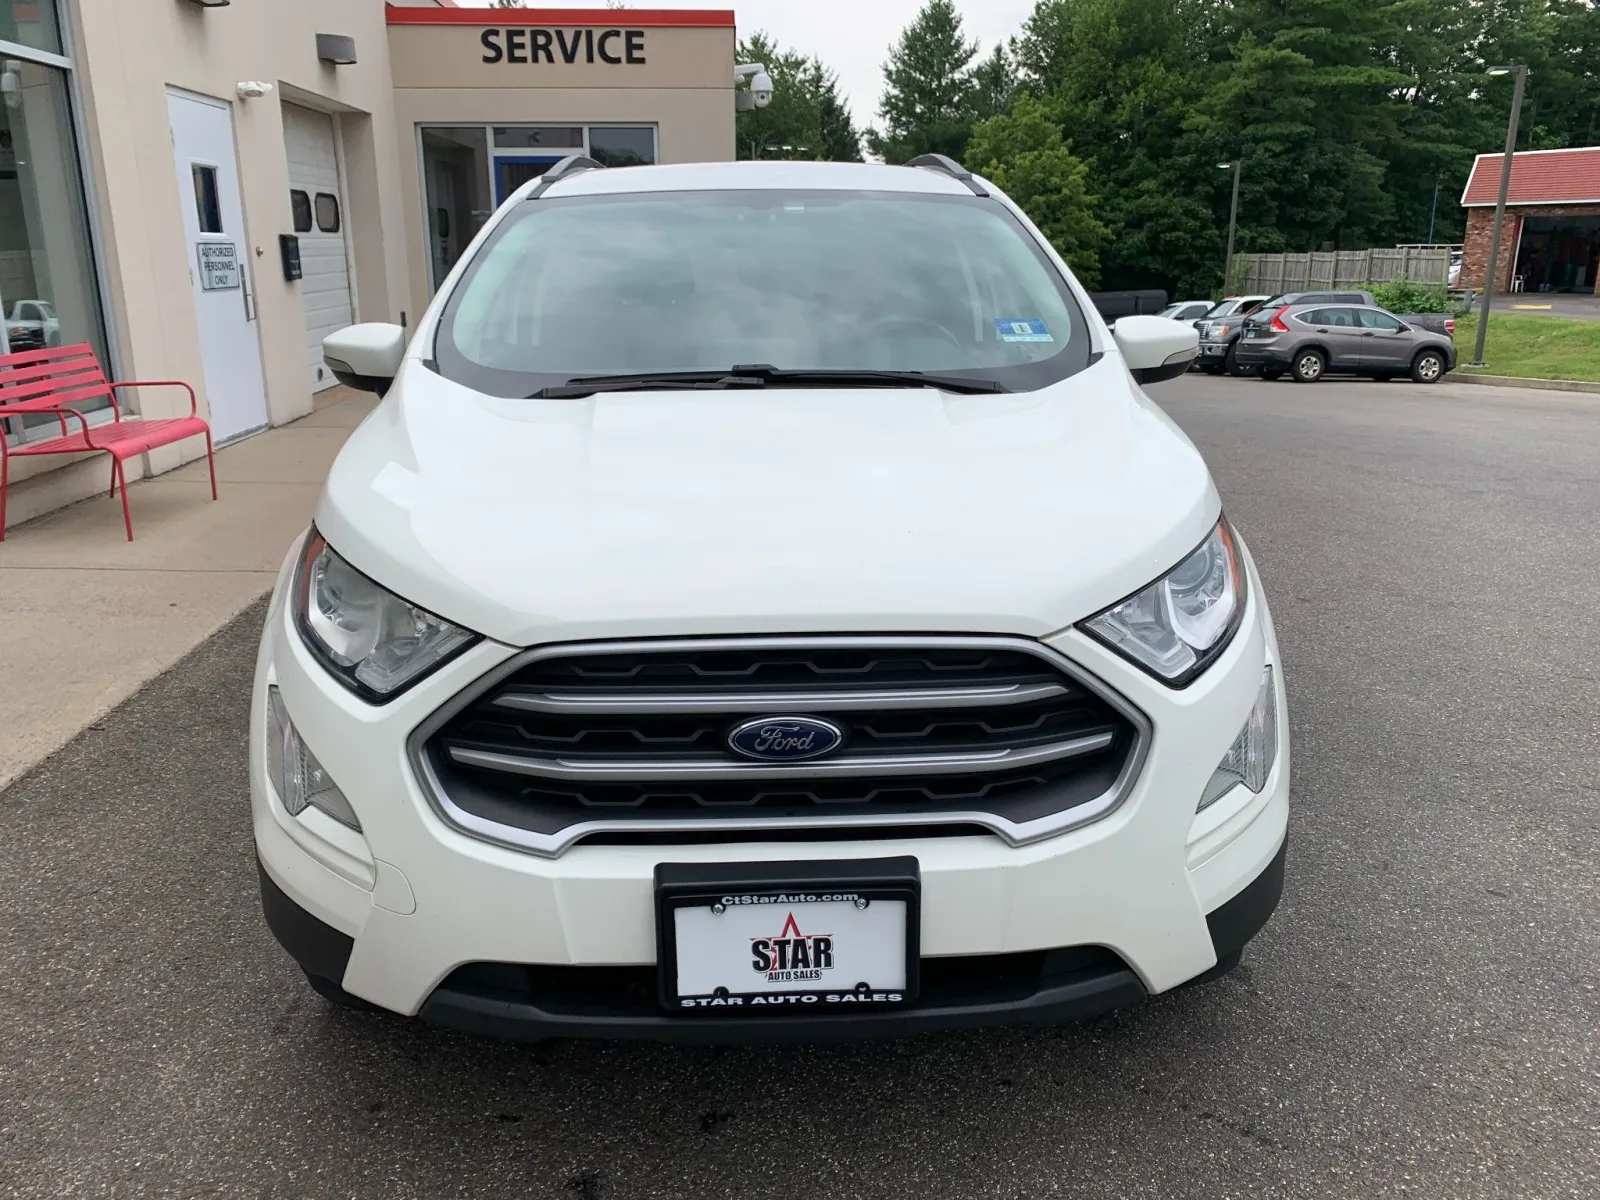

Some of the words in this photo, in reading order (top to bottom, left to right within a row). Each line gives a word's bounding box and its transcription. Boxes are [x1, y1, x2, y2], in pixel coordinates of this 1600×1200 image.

[480, 28, 646, 65] SERVICE
[201, 247, 234, 257] AUTHORIZED
[203, 261, 236, 271] PERSONNEL
[214, 275, 229, 285] ONLY
[754, 725, 815, 752] Ford
[721, 892, 859, 906] CtStarAuto.com
[751, 937, 833, 972] STAR
[768, 971, 792, 981] AUTO
[793, 969, 820, 980] SALES
[681, 996, 743, 1008] STAR
[751, 994, 818, 1005] AUTO
[826, 993, 903, 1003] SALES
